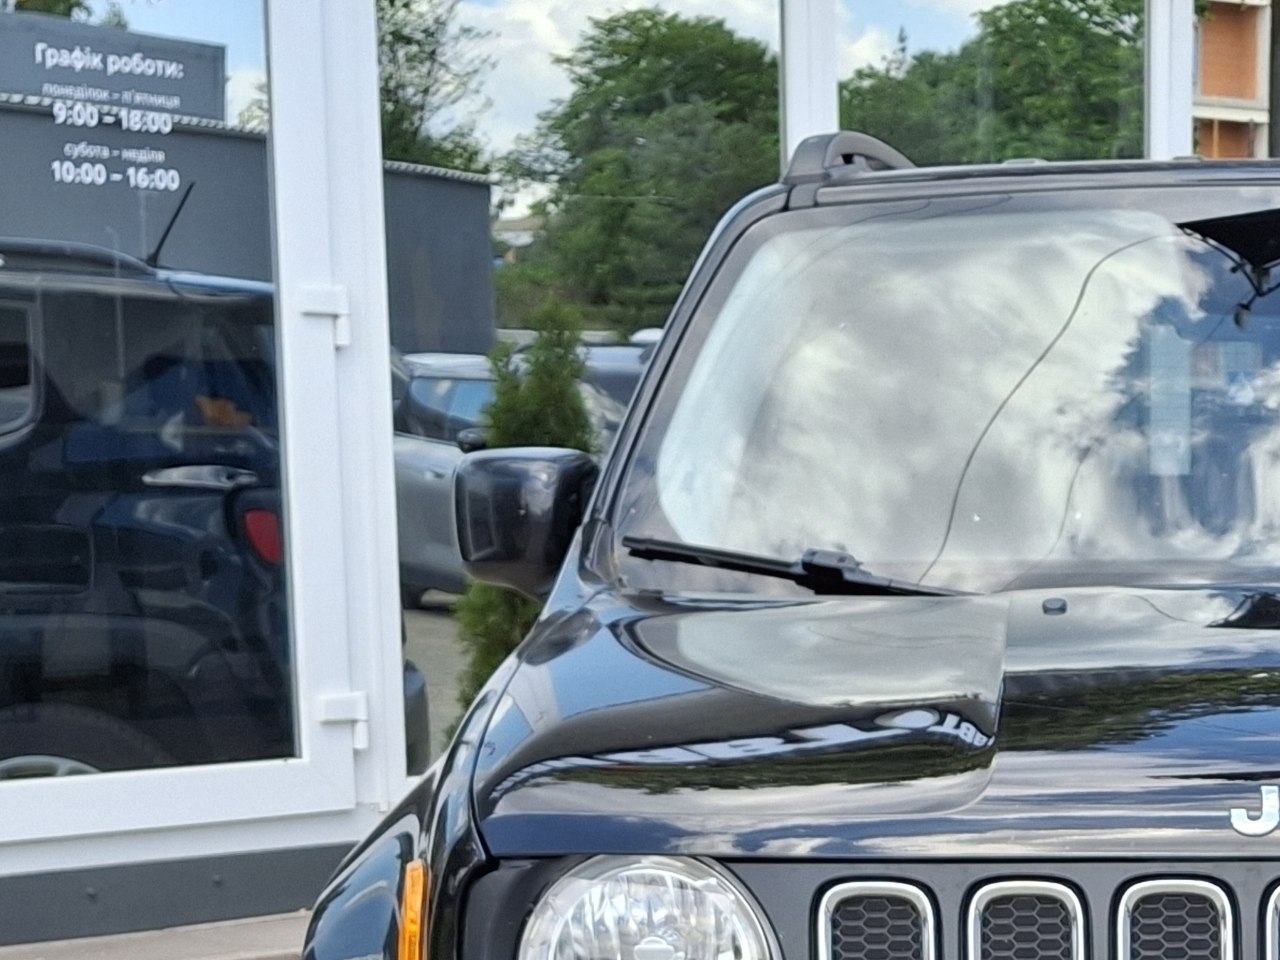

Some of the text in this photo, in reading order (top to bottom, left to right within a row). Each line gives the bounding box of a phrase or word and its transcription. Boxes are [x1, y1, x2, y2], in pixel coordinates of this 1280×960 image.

[34, 42, 184, 79] Графік роботи:
[53, 102, 99, 128] 9:00
[119, 107, 173, 134] 18:00
[63, 141, 111, 160] субота
[121, 147, 166, 163] неділя
[51, 160, 107, 186] 10:00
[126, 166, 181, 192] 16:00
